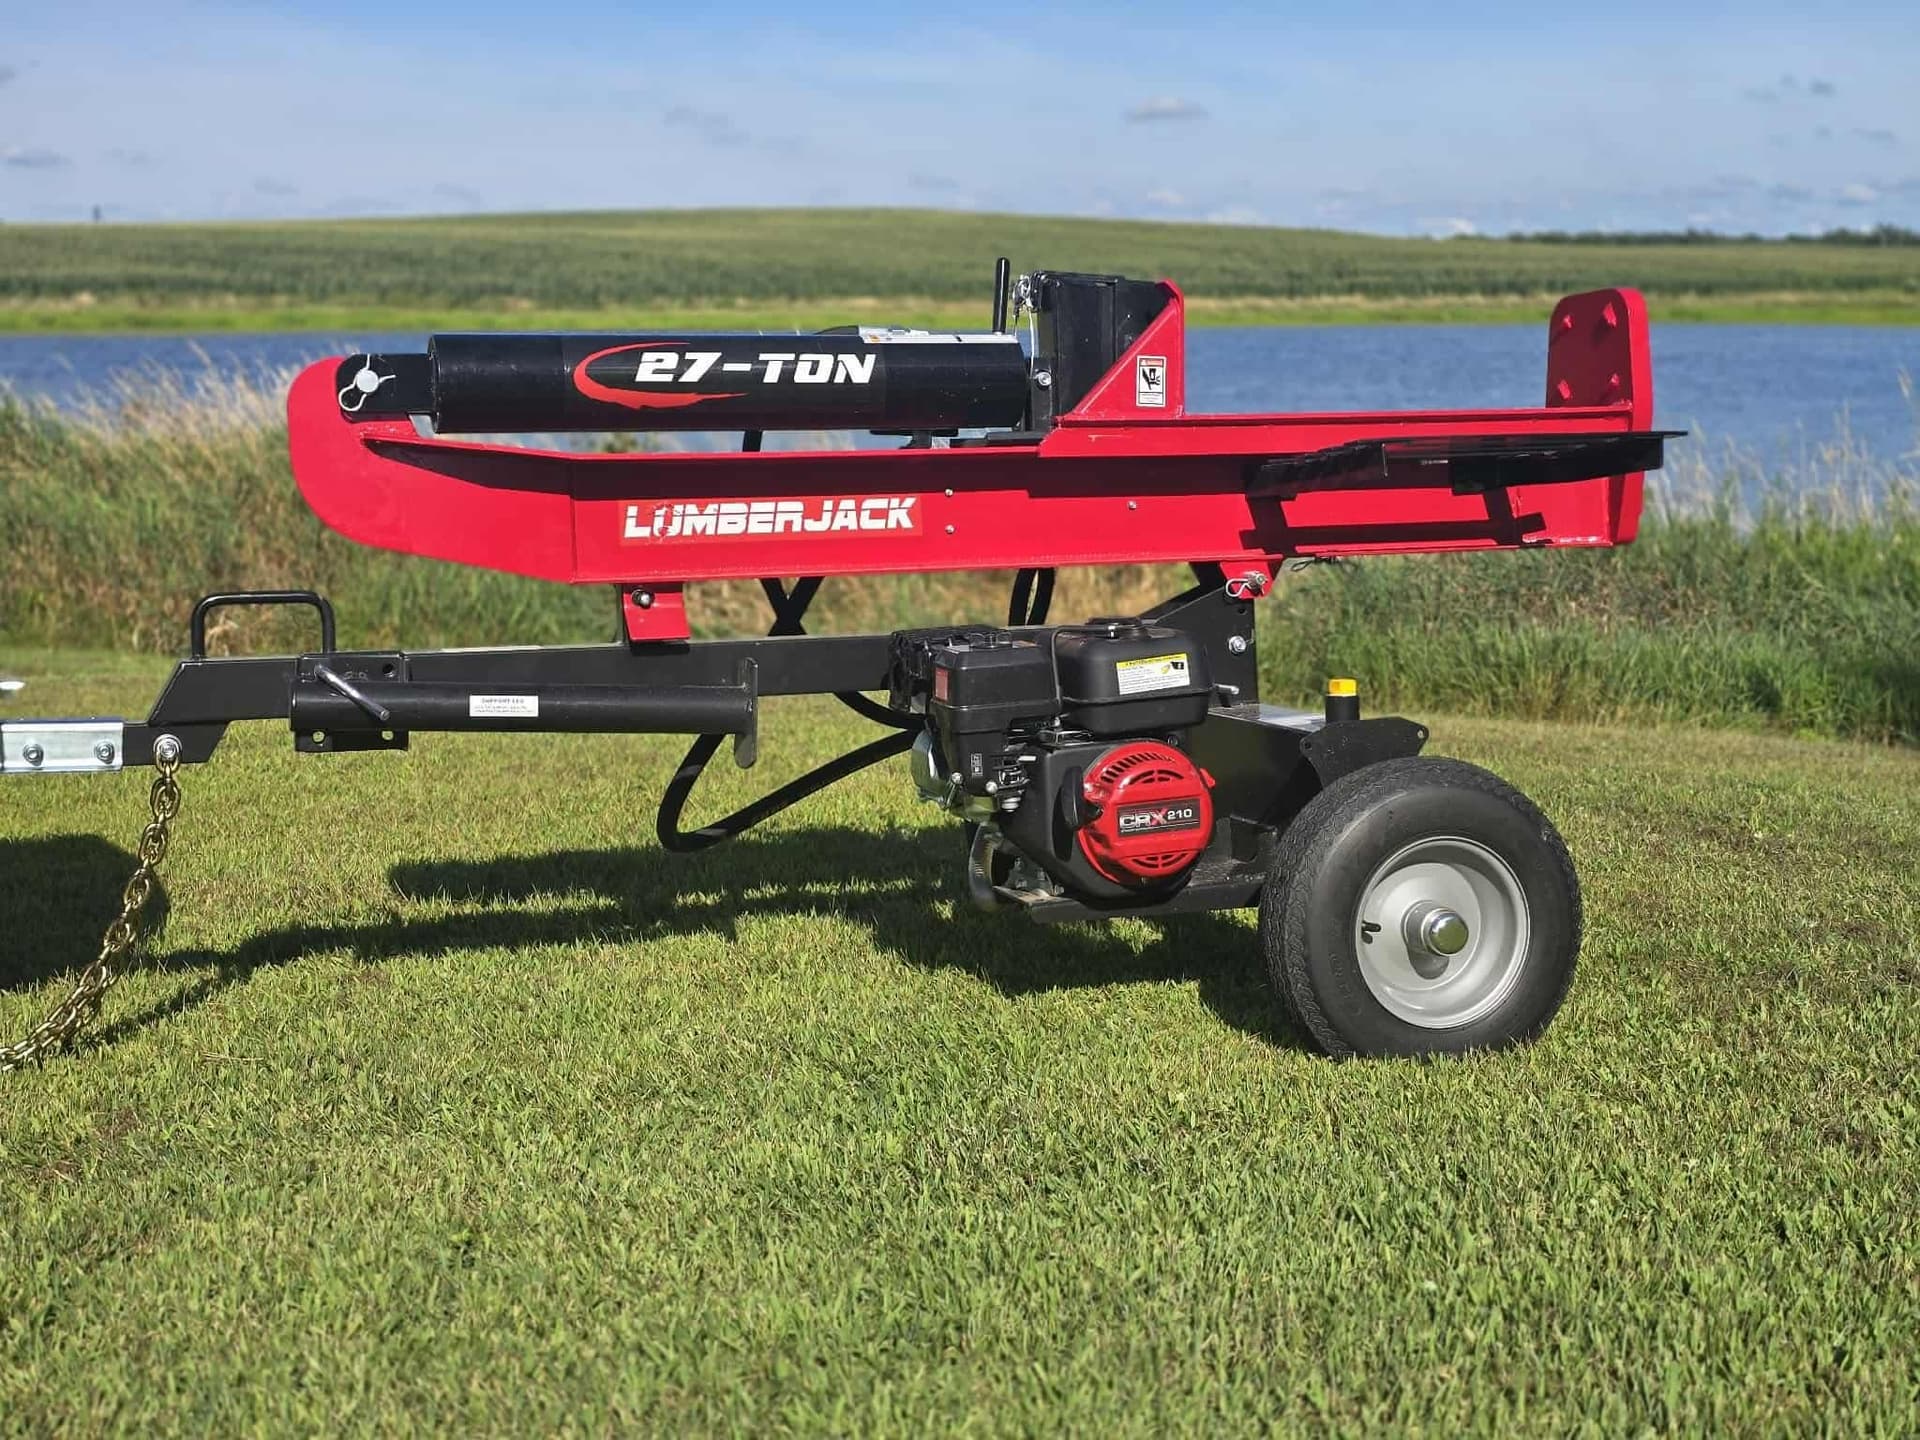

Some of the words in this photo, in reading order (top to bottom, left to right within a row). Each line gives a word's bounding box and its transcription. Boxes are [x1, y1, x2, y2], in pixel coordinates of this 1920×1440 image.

[635, 351, 876, 383] 27-TON
[623, 497, 916, 538] LUMBERJACK
[1119, 808, 1168, 829] CRX
[1167, 808, 1192, 820] 210
